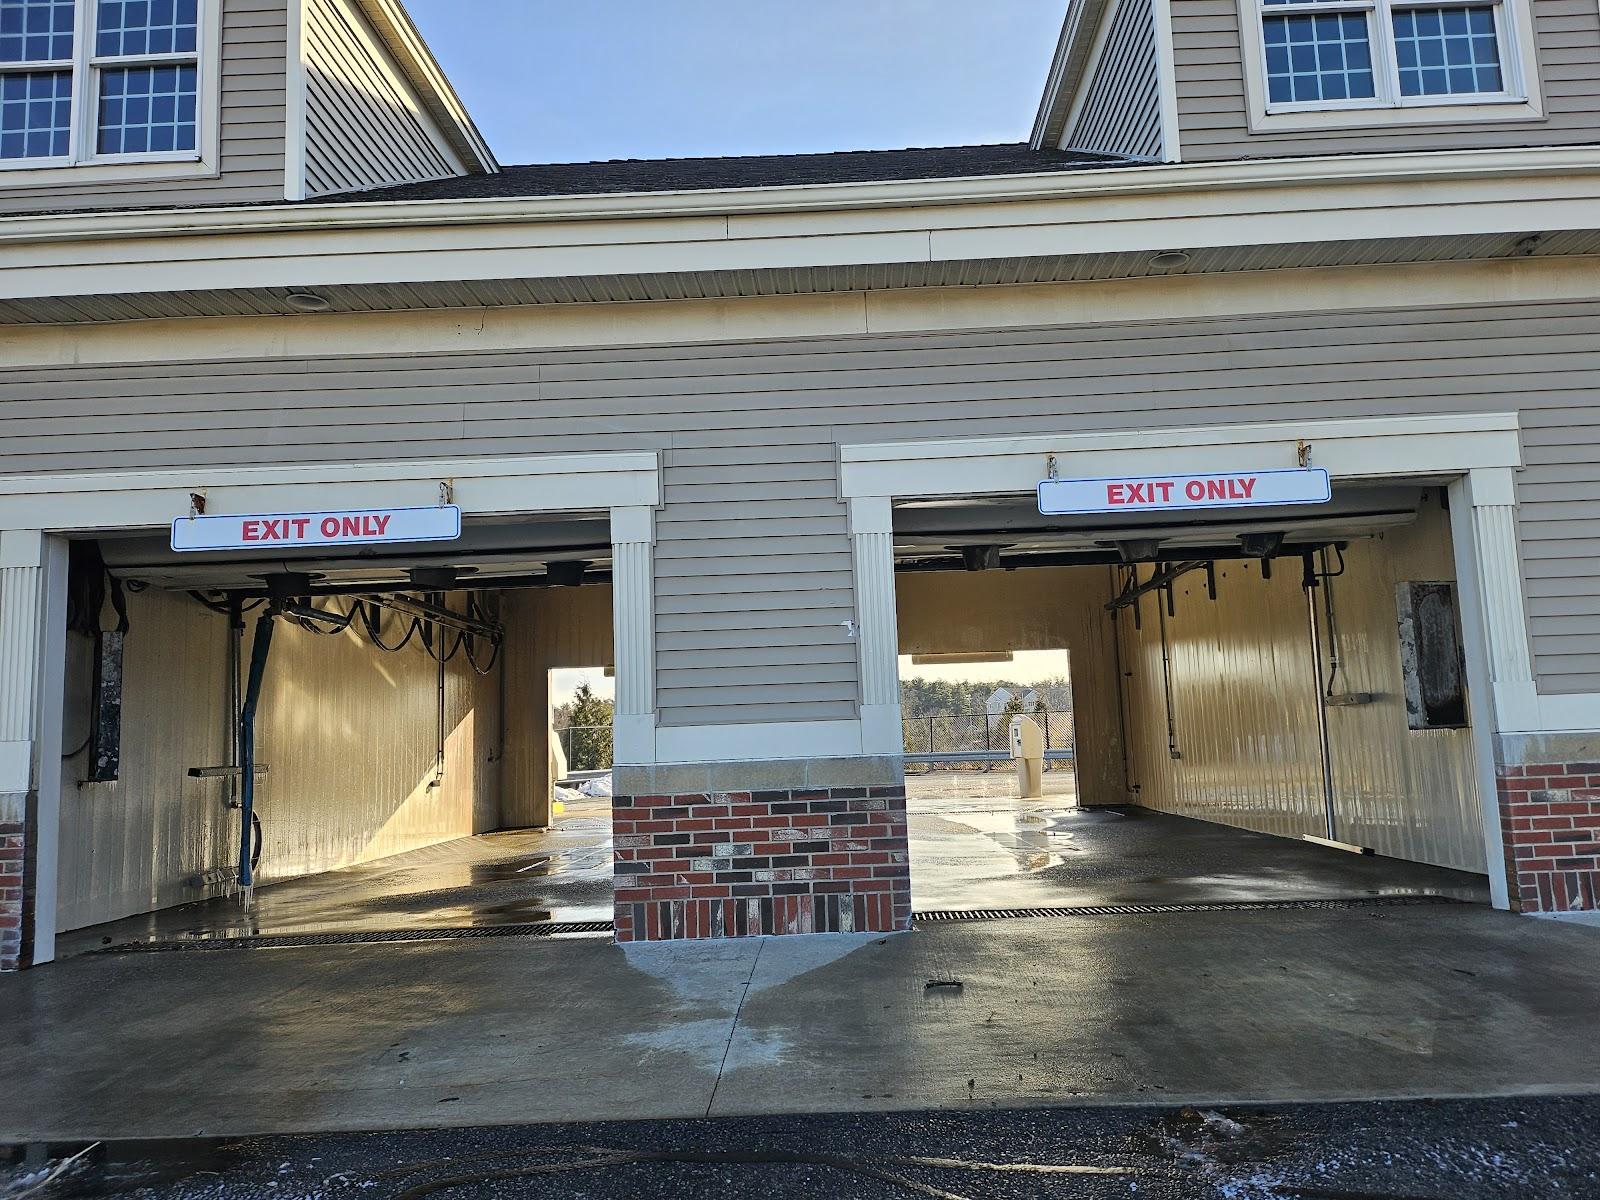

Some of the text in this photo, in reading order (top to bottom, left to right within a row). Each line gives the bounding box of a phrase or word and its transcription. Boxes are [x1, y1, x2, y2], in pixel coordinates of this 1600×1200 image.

[1107, 478, 1256, 504] EXIT ONLY
[242, 515, 391, 541] EXIT ONLY
